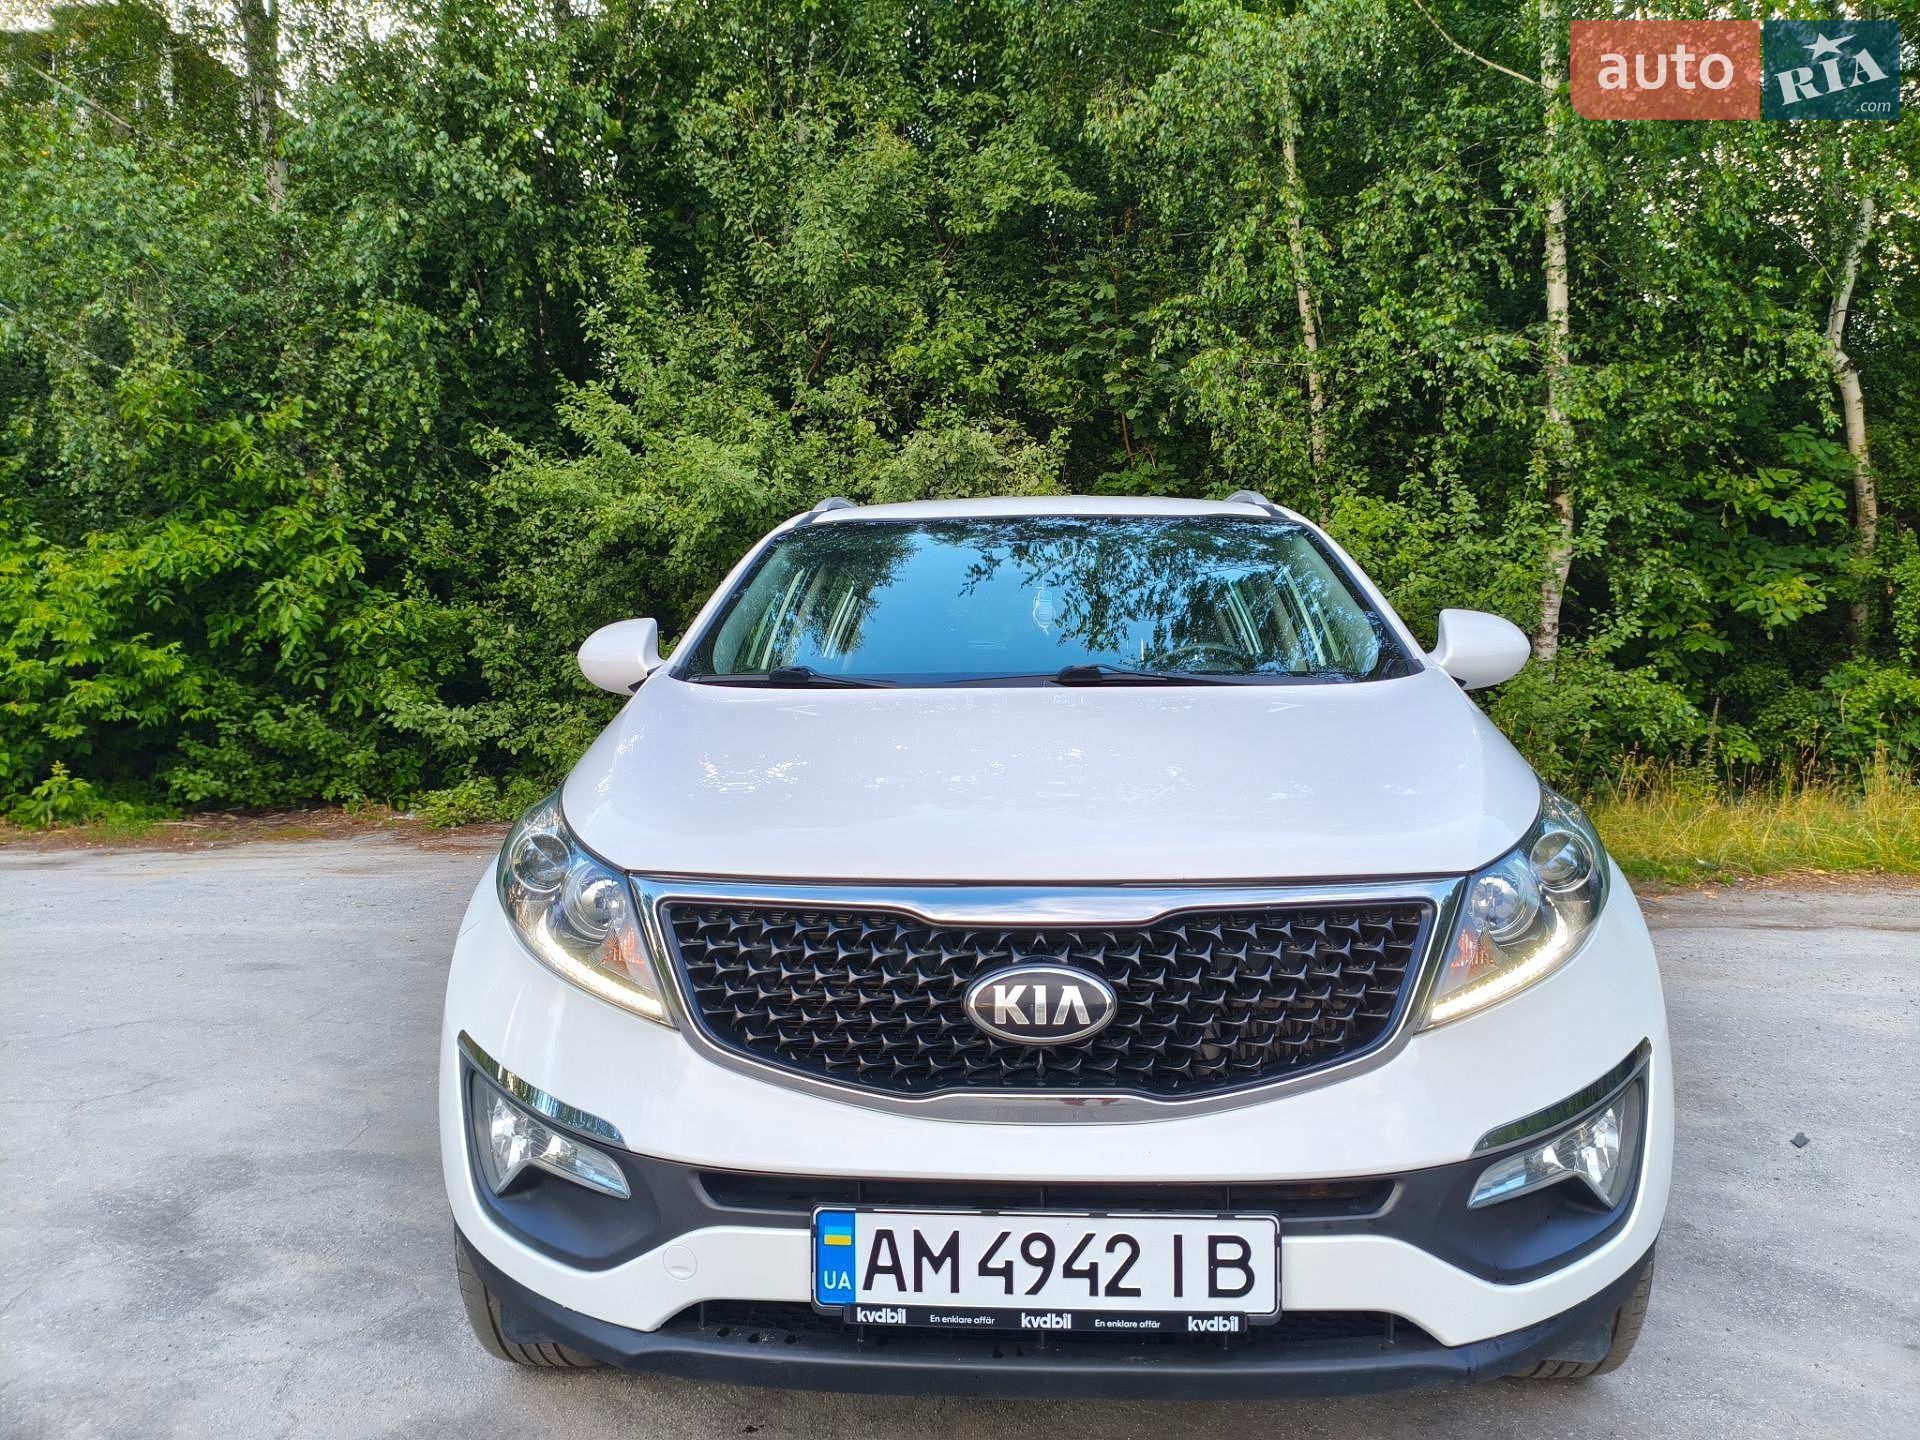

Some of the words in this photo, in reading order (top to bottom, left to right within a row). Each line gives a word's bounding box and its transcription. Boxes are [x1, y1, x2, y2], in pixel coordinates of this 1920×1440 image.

[993, 985, 1091, 1025] KIA
[862, 1228, 961, 1294] AM
[977, 1231, 1142, 1298] 4942
[1173, 1234, 1256, 1298] IB
[823, 1269, 852, 1291] UA
[856, 1307, 907, 1324] kvdbil
[929, 1314, 941, 1323] En
[941, 1315, 972, 1324] enklare
[973, 1315, 996, 1325] affär
[1021, 1312, 1072, 1329] kvdbil
[1094, 1319, 1106, 1328] En
[1106, 1319, 1138, 1328] enklare
[1139, 1319, 1161, 1329] affär
[1187, 1316, 1239, 1332] kvdbil
